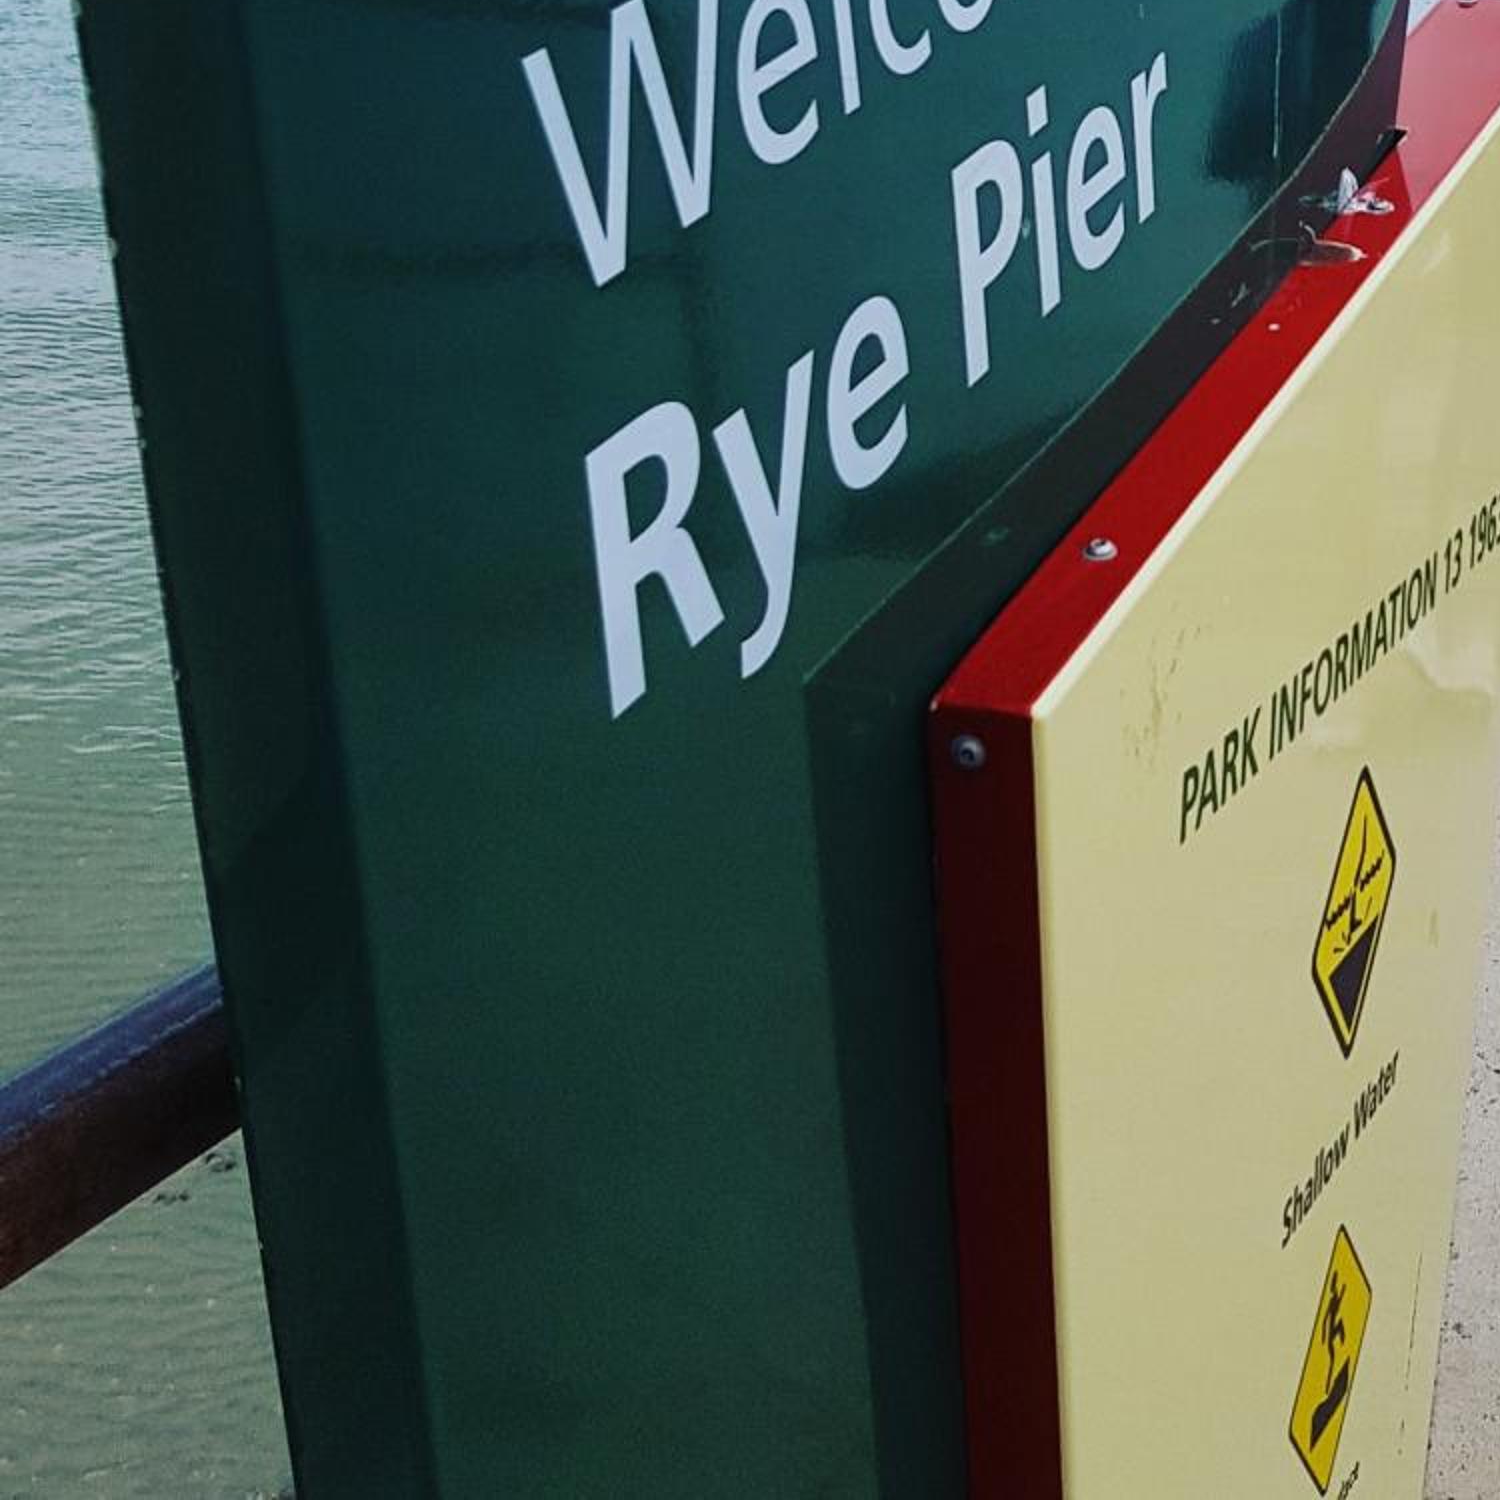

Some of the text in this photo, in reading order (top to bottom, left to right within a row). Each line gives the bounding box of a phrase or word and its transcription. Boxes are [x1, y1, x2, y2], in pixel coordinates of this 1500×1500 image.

[585, 51, 1168, 719] Rye Pier
[1179, 706, 1261, 845] PARK
[1268, 550, 1438, 761] INFORMATION
[1443, 528, 1464, 594] 13
[1281, 1049, 1400, 1249] Shallow Water
